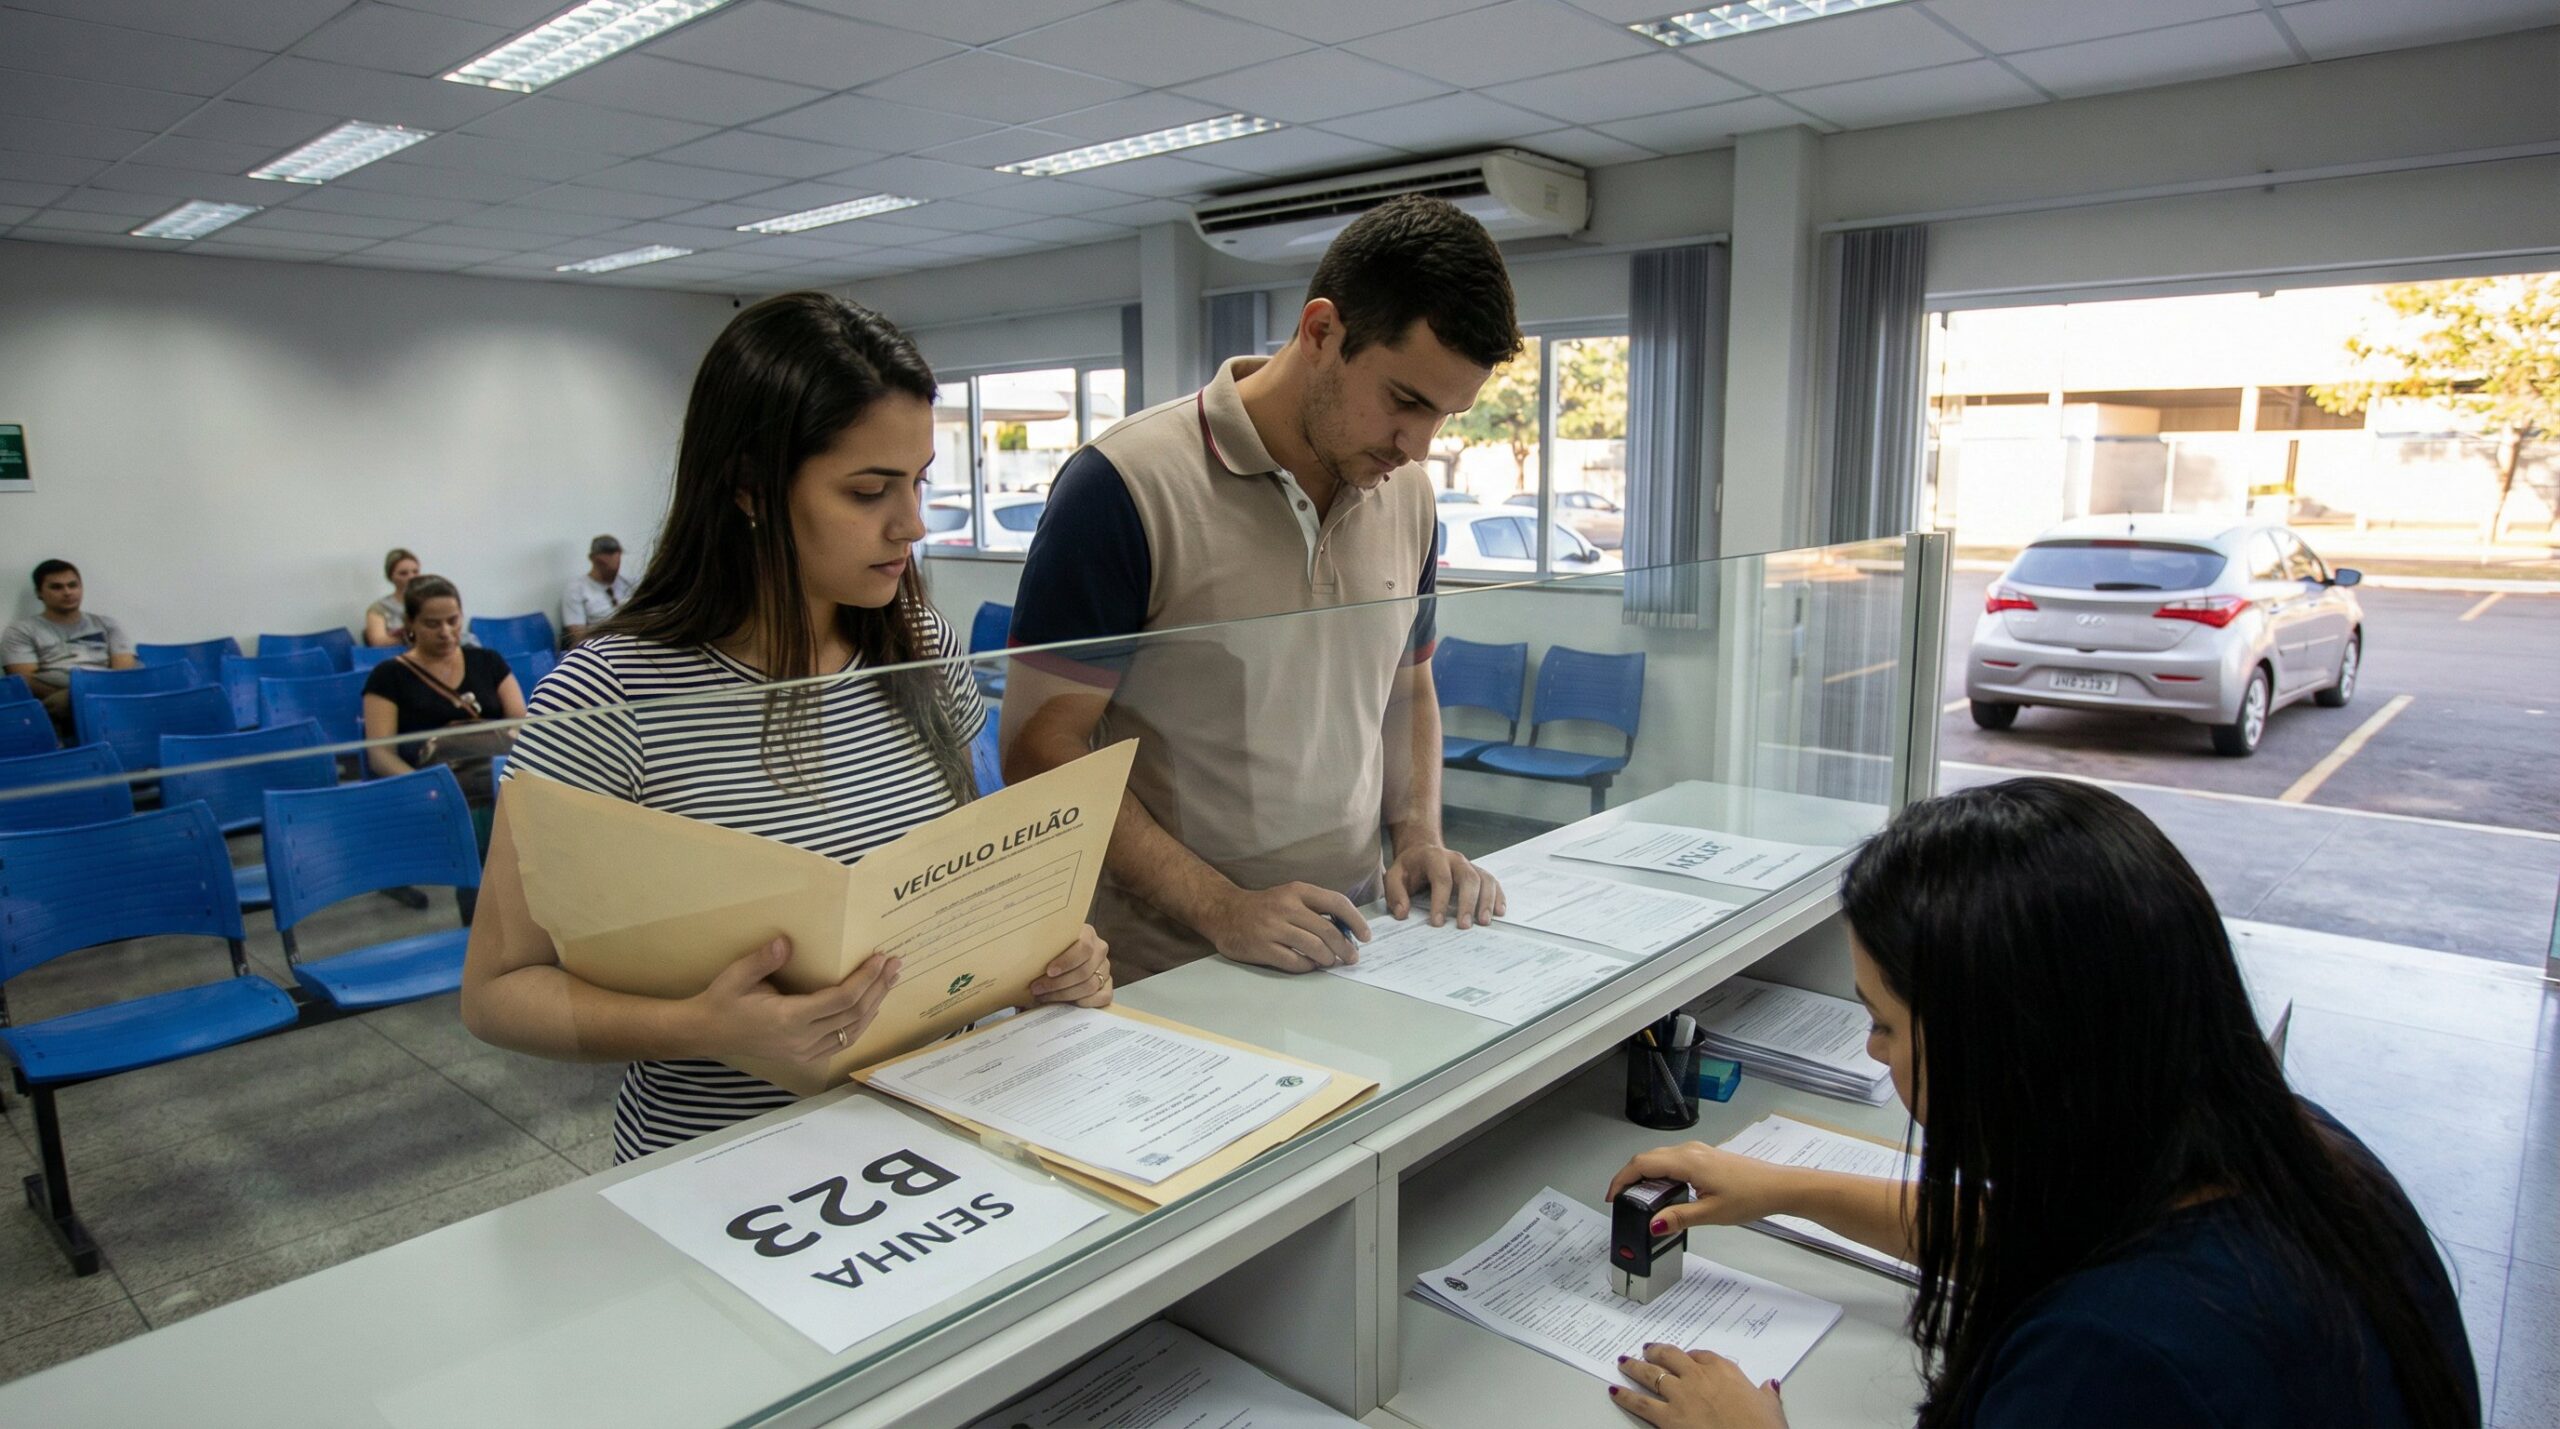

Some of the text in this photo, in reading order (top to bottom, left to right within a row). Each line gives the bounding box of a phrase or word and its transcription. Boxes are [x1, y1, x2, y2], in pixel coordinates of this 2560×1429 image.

[892, 842, 995, 903] VEÍCULO
[1001, 805, 1081, 853] LEILÃO
[725, 1148, 961, 1258] B23
[811, 1192, 1015, 1289] SENHA
